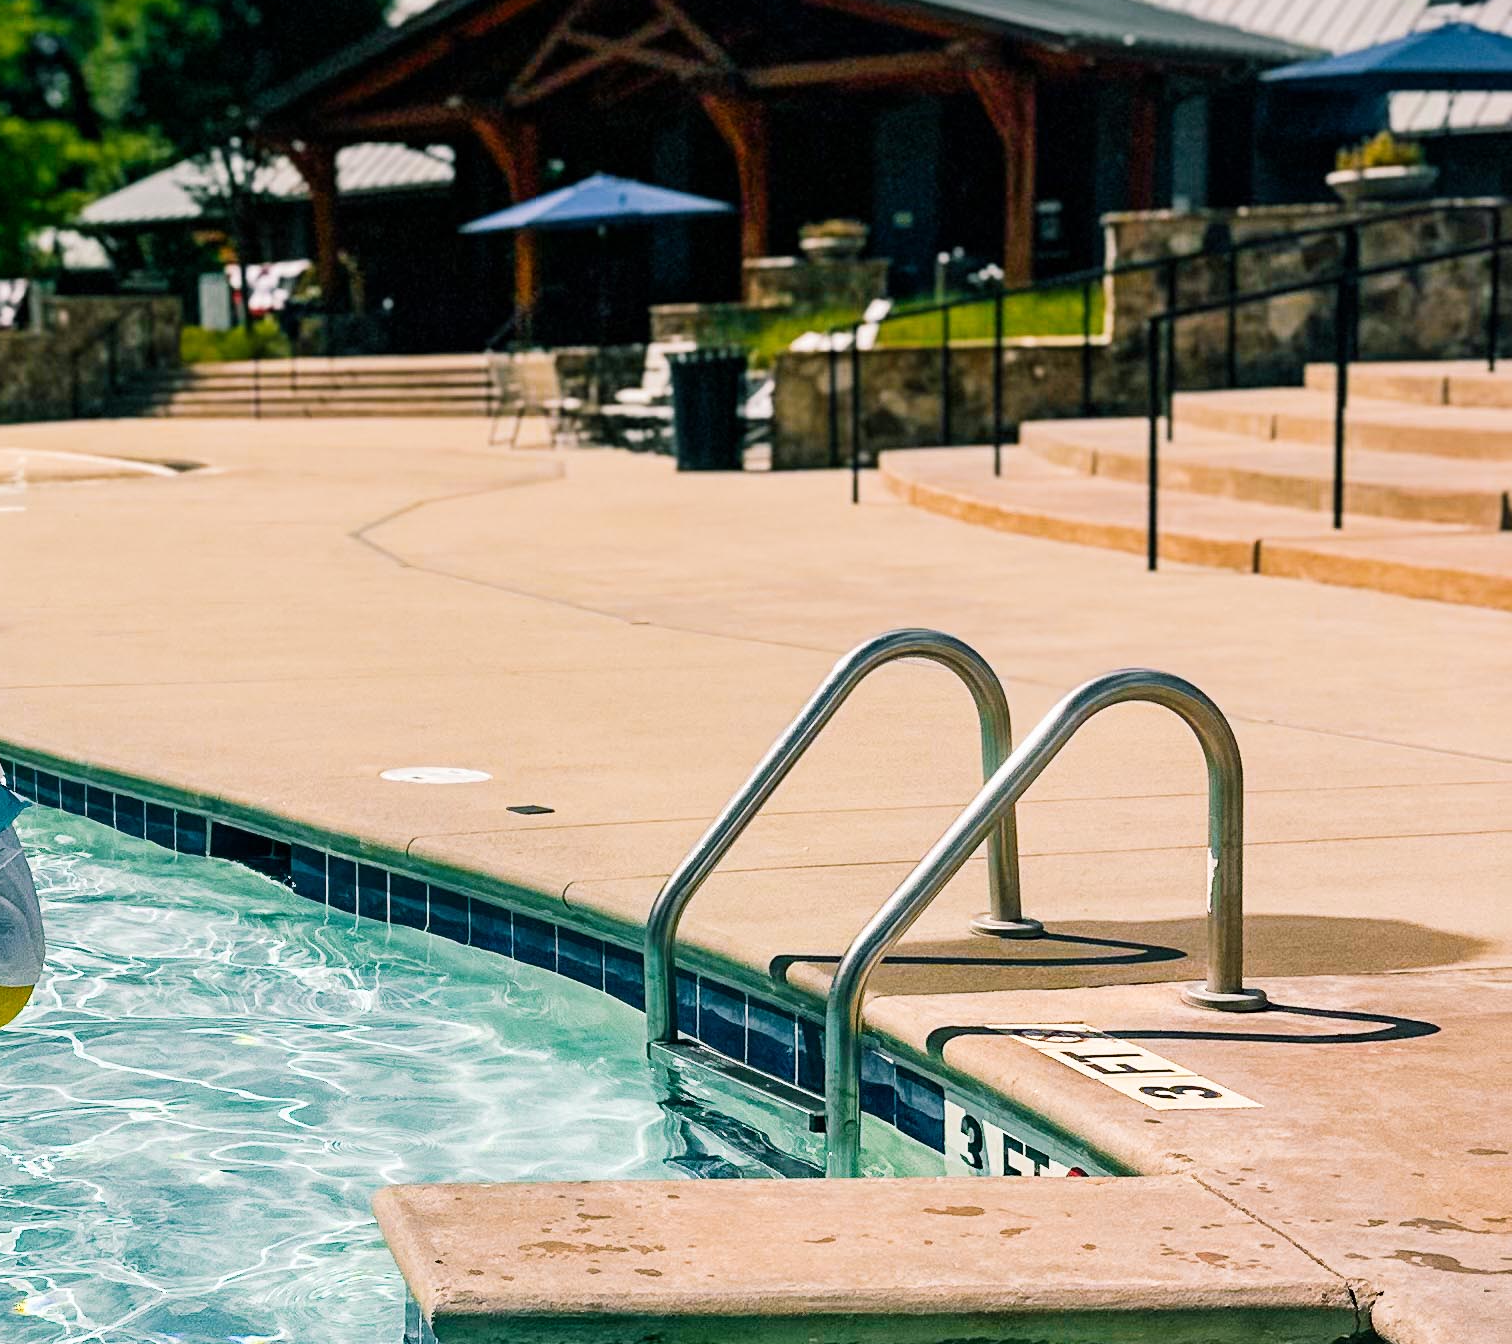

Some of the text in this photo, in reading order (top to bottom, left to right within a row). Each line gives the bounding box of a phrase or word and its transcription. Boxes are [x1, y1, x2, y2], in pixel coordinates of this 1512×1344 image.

[1059, 1050, 1223, 1100] 3 FT
[960, 1114, 1050, 1177] 3 FT
